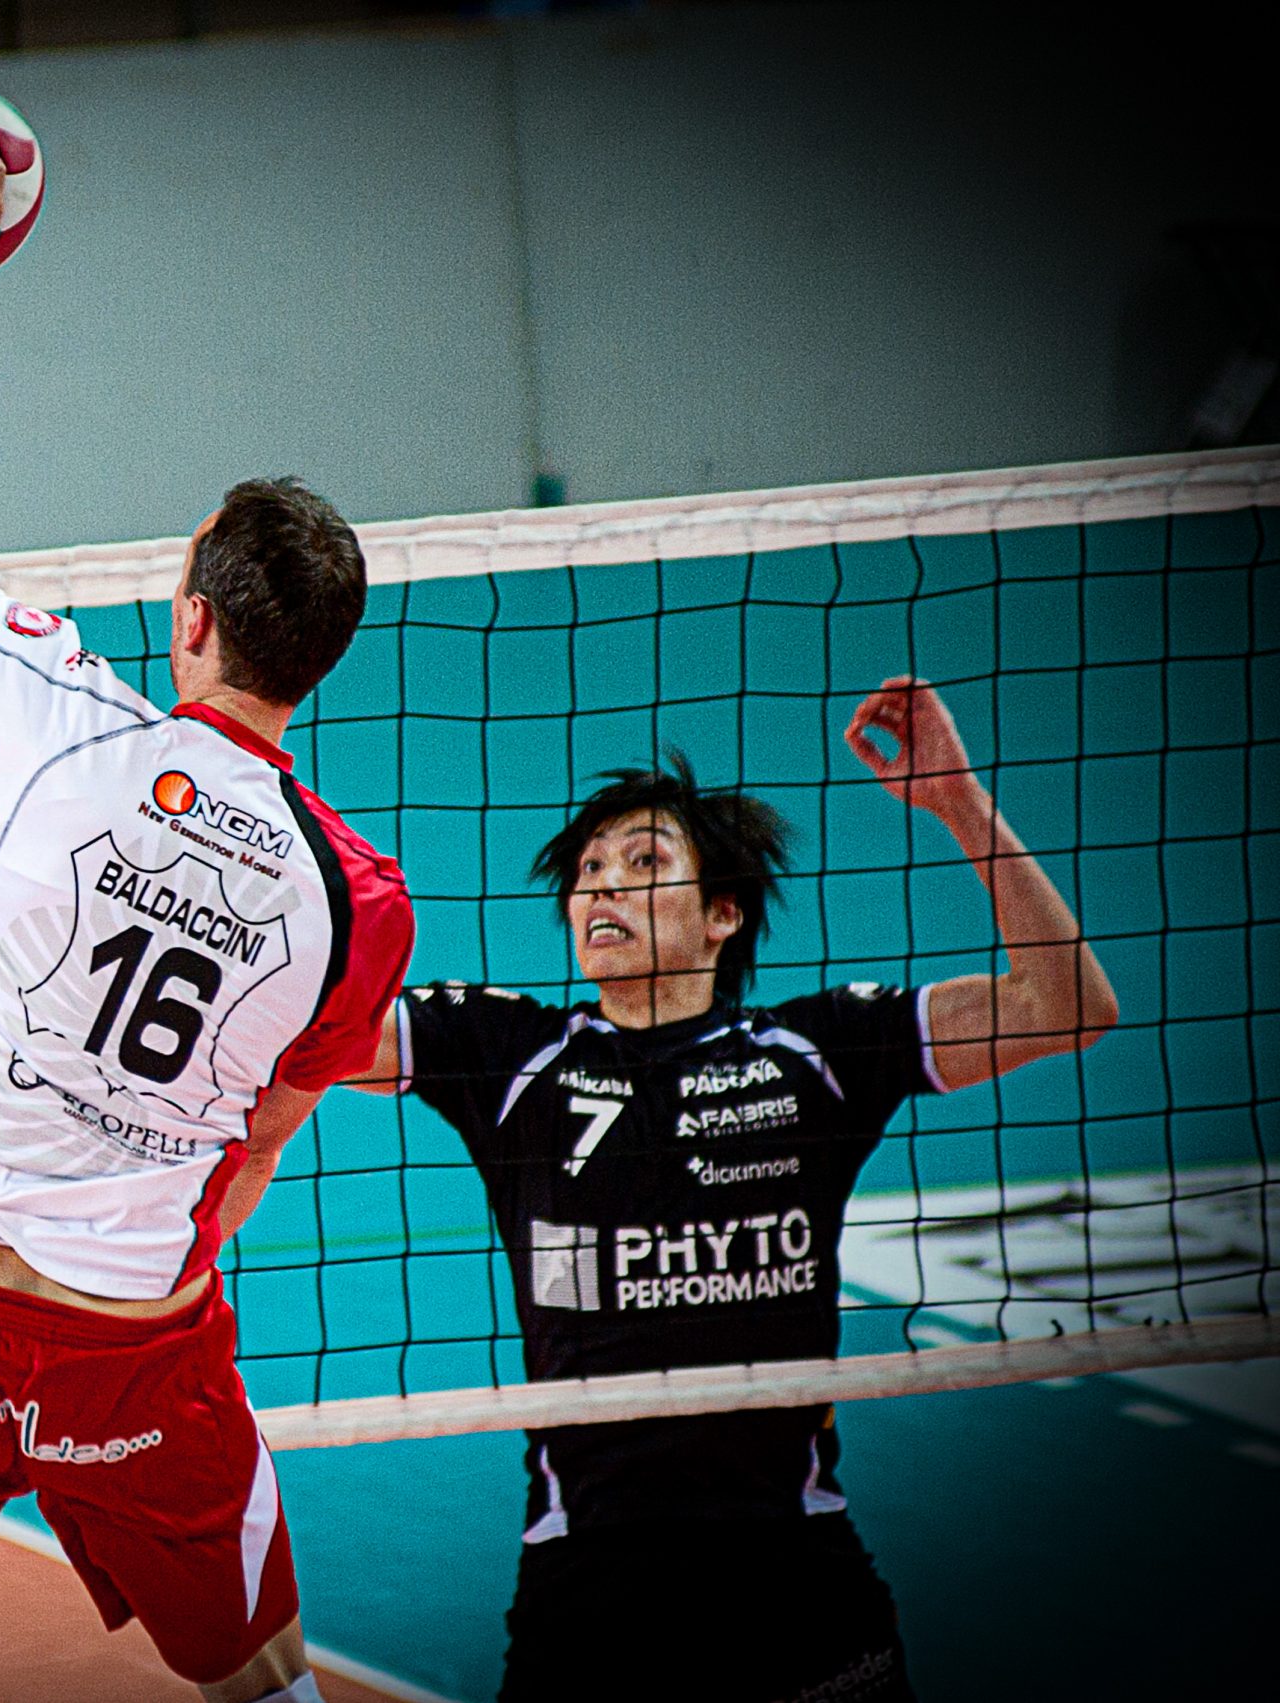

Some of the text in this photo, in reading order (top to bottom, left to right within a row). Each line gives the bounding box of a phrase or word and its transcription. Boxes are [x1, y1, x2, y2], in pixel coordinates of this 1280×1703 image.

[187, 790, 294, 859] NGM
[95, 860, 267, 967] BALDACCINI
[83, 924, 223, 1085] 16
[563, 1095, 625, 1177] 7
[615, 1208, 812, 1278] PHYTO
[616, 1262, 819, 1311] PERFORMANCE
